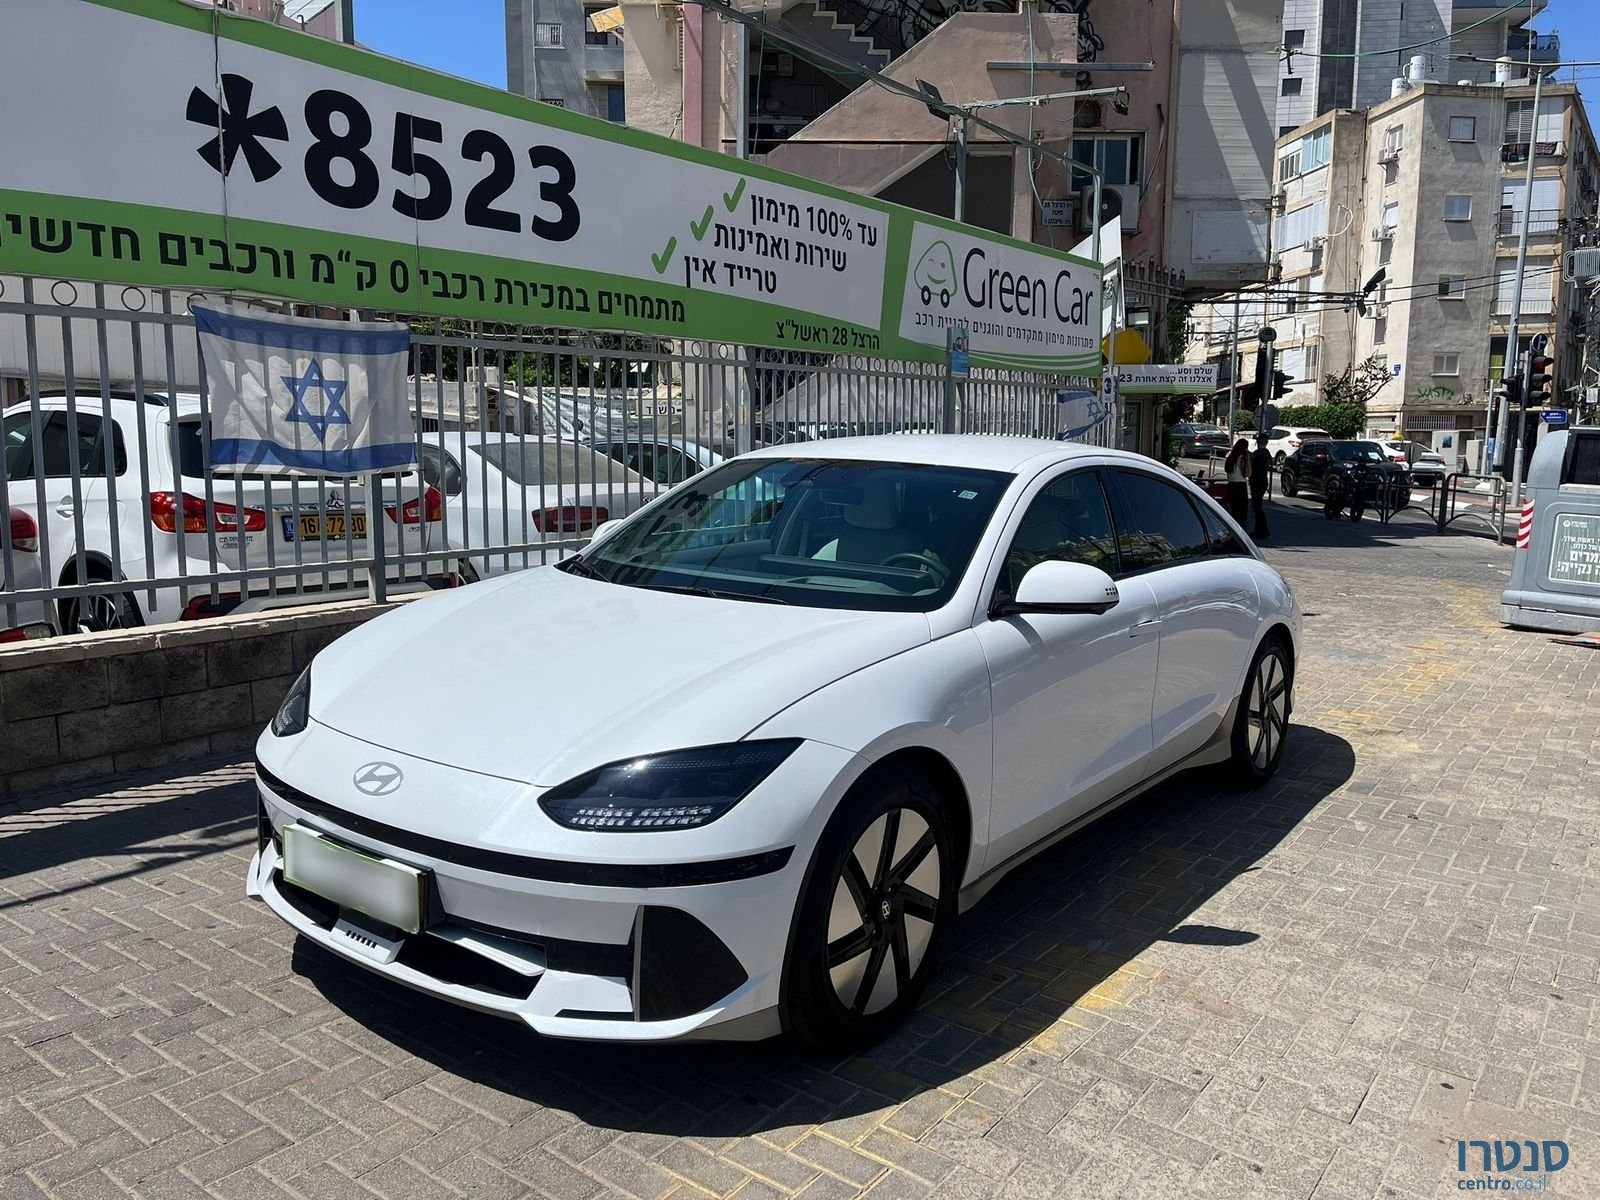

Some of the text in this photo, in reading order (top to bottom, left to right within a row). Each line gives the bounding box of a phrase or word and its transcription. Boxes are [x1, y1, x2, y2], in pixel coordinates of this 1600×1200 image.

[751, 194, 877, 247] עד 100% מימון
[0, 213, 141, 262] חדשי
[714, 223, 846, 272] שירות ואמינות
[159, 232, 295, 280] ורכבים
[390, 259, 409, 293] 0
[684, 255, 777, 294] טרייד אין
[419, 269, 485, 302] רכבי
[494, 277, 591, 312] במכירת
[963, 247, 1094, 326] Green Car
[598, 290, 685, 323] מתמחים
[915, 312, 934, 327] רכב
[973, 321, 1004, 337] והוגנים
[832, 326, 848, 346] 28
[851, 327, 880, 350] הרצל
[1007, 326, 1043, 344] מתקדמים
[1046, 331, 1065, 346] מימון
[1067, 336, 1094, 349] פתרונות
[1135, 375, 1157, 383] אחרת
[1159, 375, 1176, 384] קצת
[1178, 375, 1188, 383] זה
[1190, 374, 1212, 383] אצלנו
[1194, 366, 1213, 375] שלם
[1557, 560, 1593, 576] נקייה!
